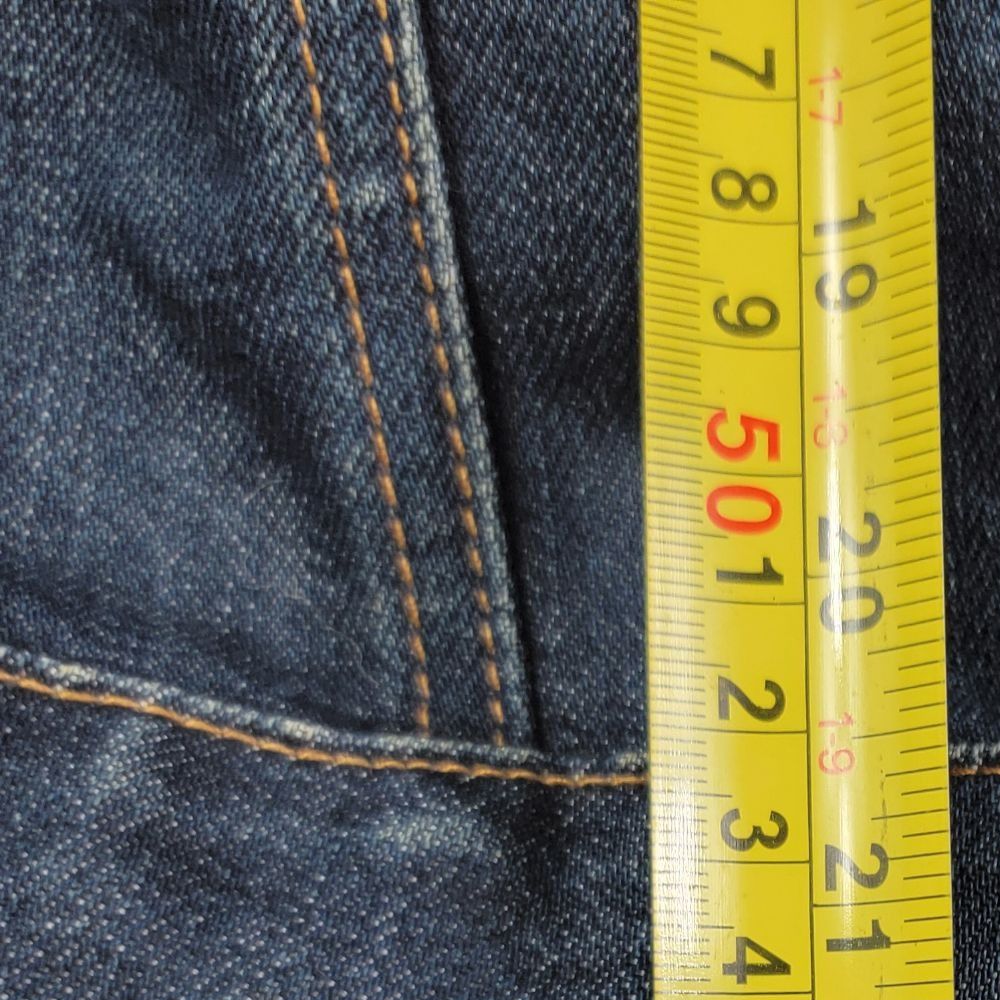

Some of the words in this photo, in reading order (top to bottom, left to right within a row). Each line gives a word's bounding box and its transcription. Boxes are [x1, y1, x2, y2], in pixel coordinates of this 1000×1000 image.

[710, 48, 776, 90] 7
[808, 67, 843, 126] 1-7
[711, 168, 778, 211] 8
[813, 198, 878, 313] 19
[713, 295, 780, 338] 9
[706, 410, 782, 535] 50
[716, 557, 784, 585] 1
[818, 512, 885, 635] 20
[718, 675, 786, 722] 2
[818, 711, 855, 776] 1-9
[720, 808, 789, 852] 3
[825, 843, 891, 952] 21
[722, 936, 791, 985] 4
